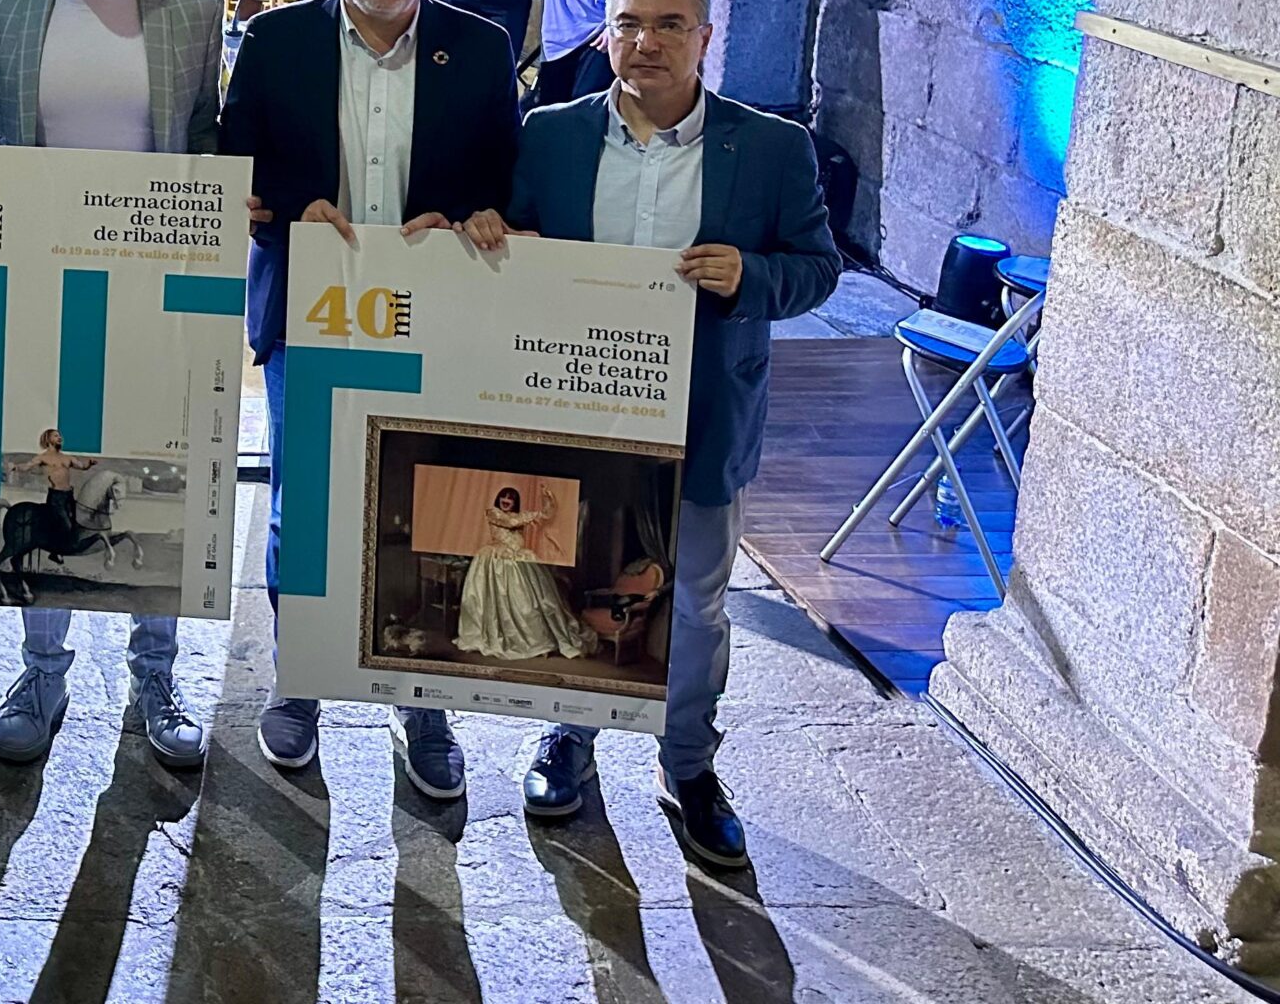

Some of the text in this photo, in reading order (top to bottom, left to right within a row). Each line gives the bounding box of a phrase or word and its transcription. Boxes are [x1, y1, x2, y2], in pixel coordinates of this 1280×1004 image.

[149, 180, 224, 195] mostra
[83, 190, 223, 212] internacional
[130, 210, 222, 229] de teatro
[94, 225, 221, 247] de ribadavia
[51, 245, 67, 255] do
[69, 246, 82, 256] 19
[84, 247, 100, 257] ao
[102, 248, 117, 257] 27
[119, 248, 135, 259] de
[171, 251, 187, 261] de
[188, 252, 220, 262] 2024
[306, 286, 395, 339] 40
[389, 290, 412, 338] mit
[587, 327, 671, 347] mostra
[514, 334, 670, 365] internacional
[565, 358, 668, 383] de teatro
[525, 372, 667, 401] de ribadavia
[479, 390, 496, 401] do
[499, 392, 513, 403] 19
[515, 395, 533, 405] ao
[535, 397, 552, 407] 27
[553, 398, 570, 409] de
[611, 403, 629, 415] de
[631, 406, 666, 418] 2024
